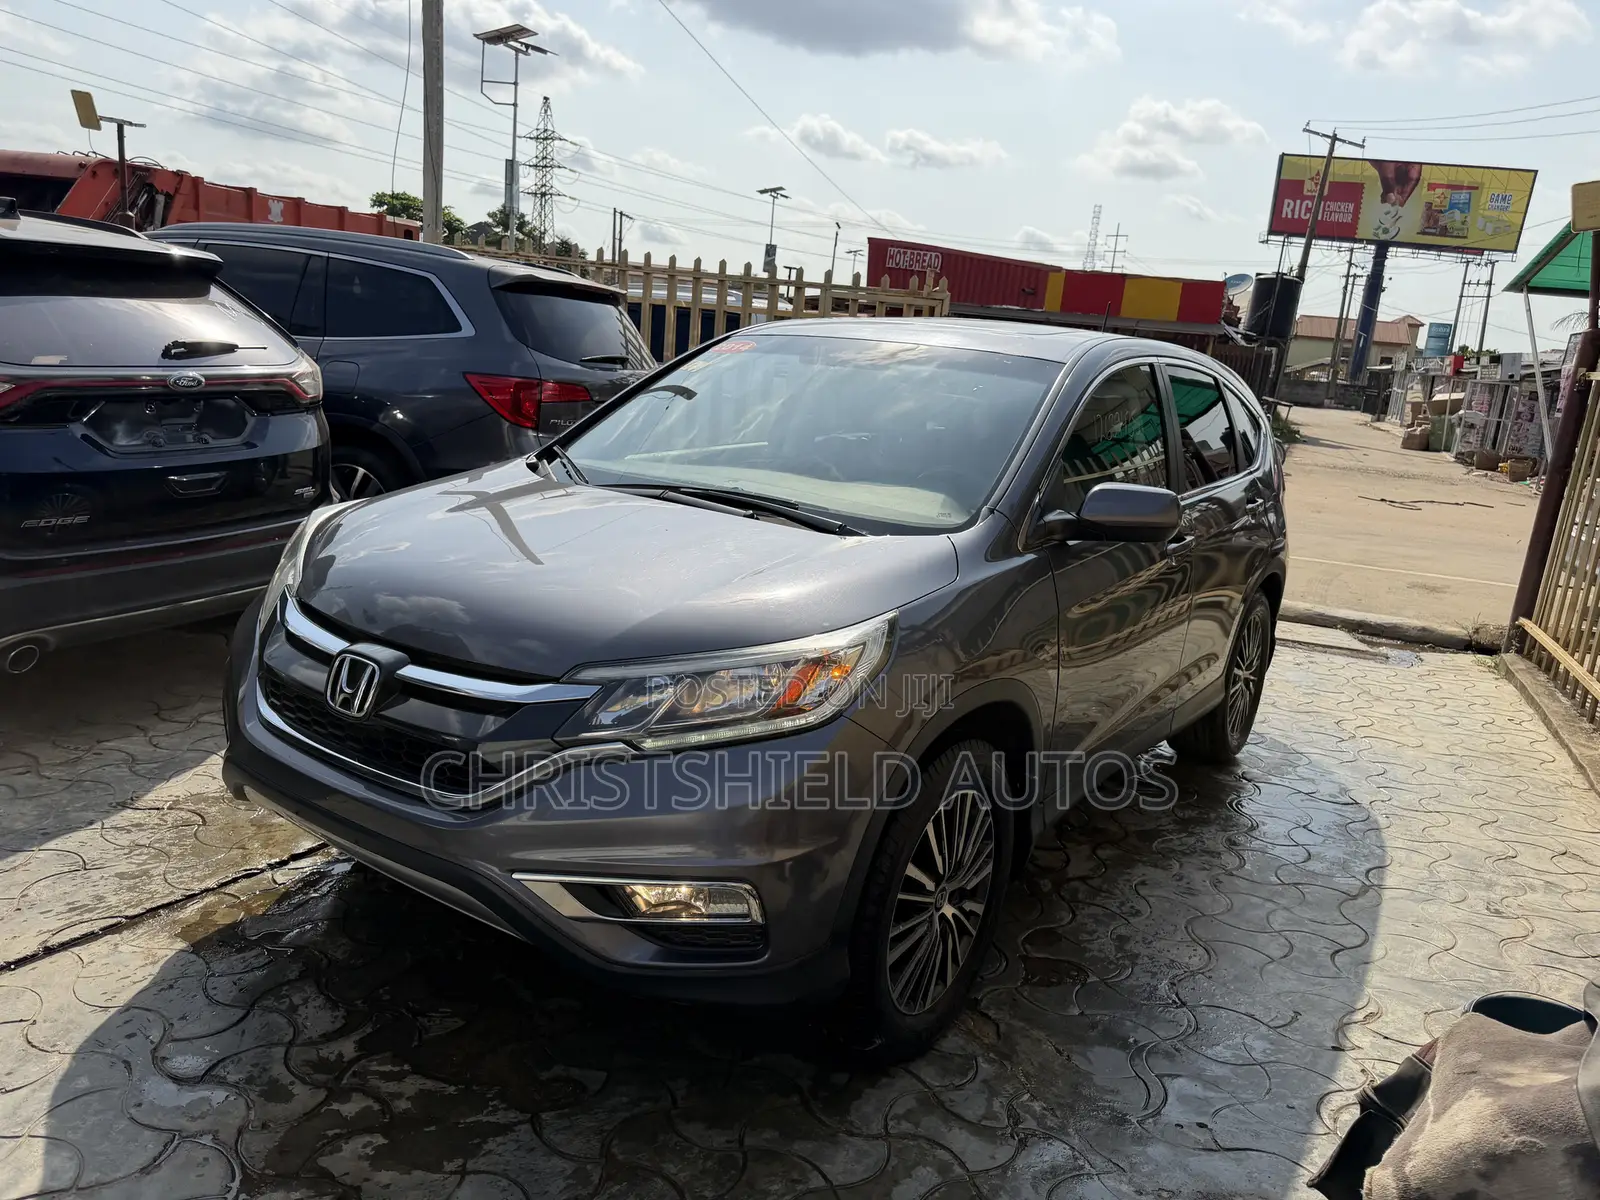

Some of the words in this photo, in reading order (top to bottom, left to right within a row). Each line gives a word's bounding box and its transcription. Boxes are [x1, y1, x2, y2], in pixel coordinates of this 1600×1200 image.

[1324, 201, 1354, 213] CHICKEN
[1323, 211, 1353, 223] FLAVOUR
[177, 377, 198, 387] Ford
[20, 515, 91, 528] EDGE
